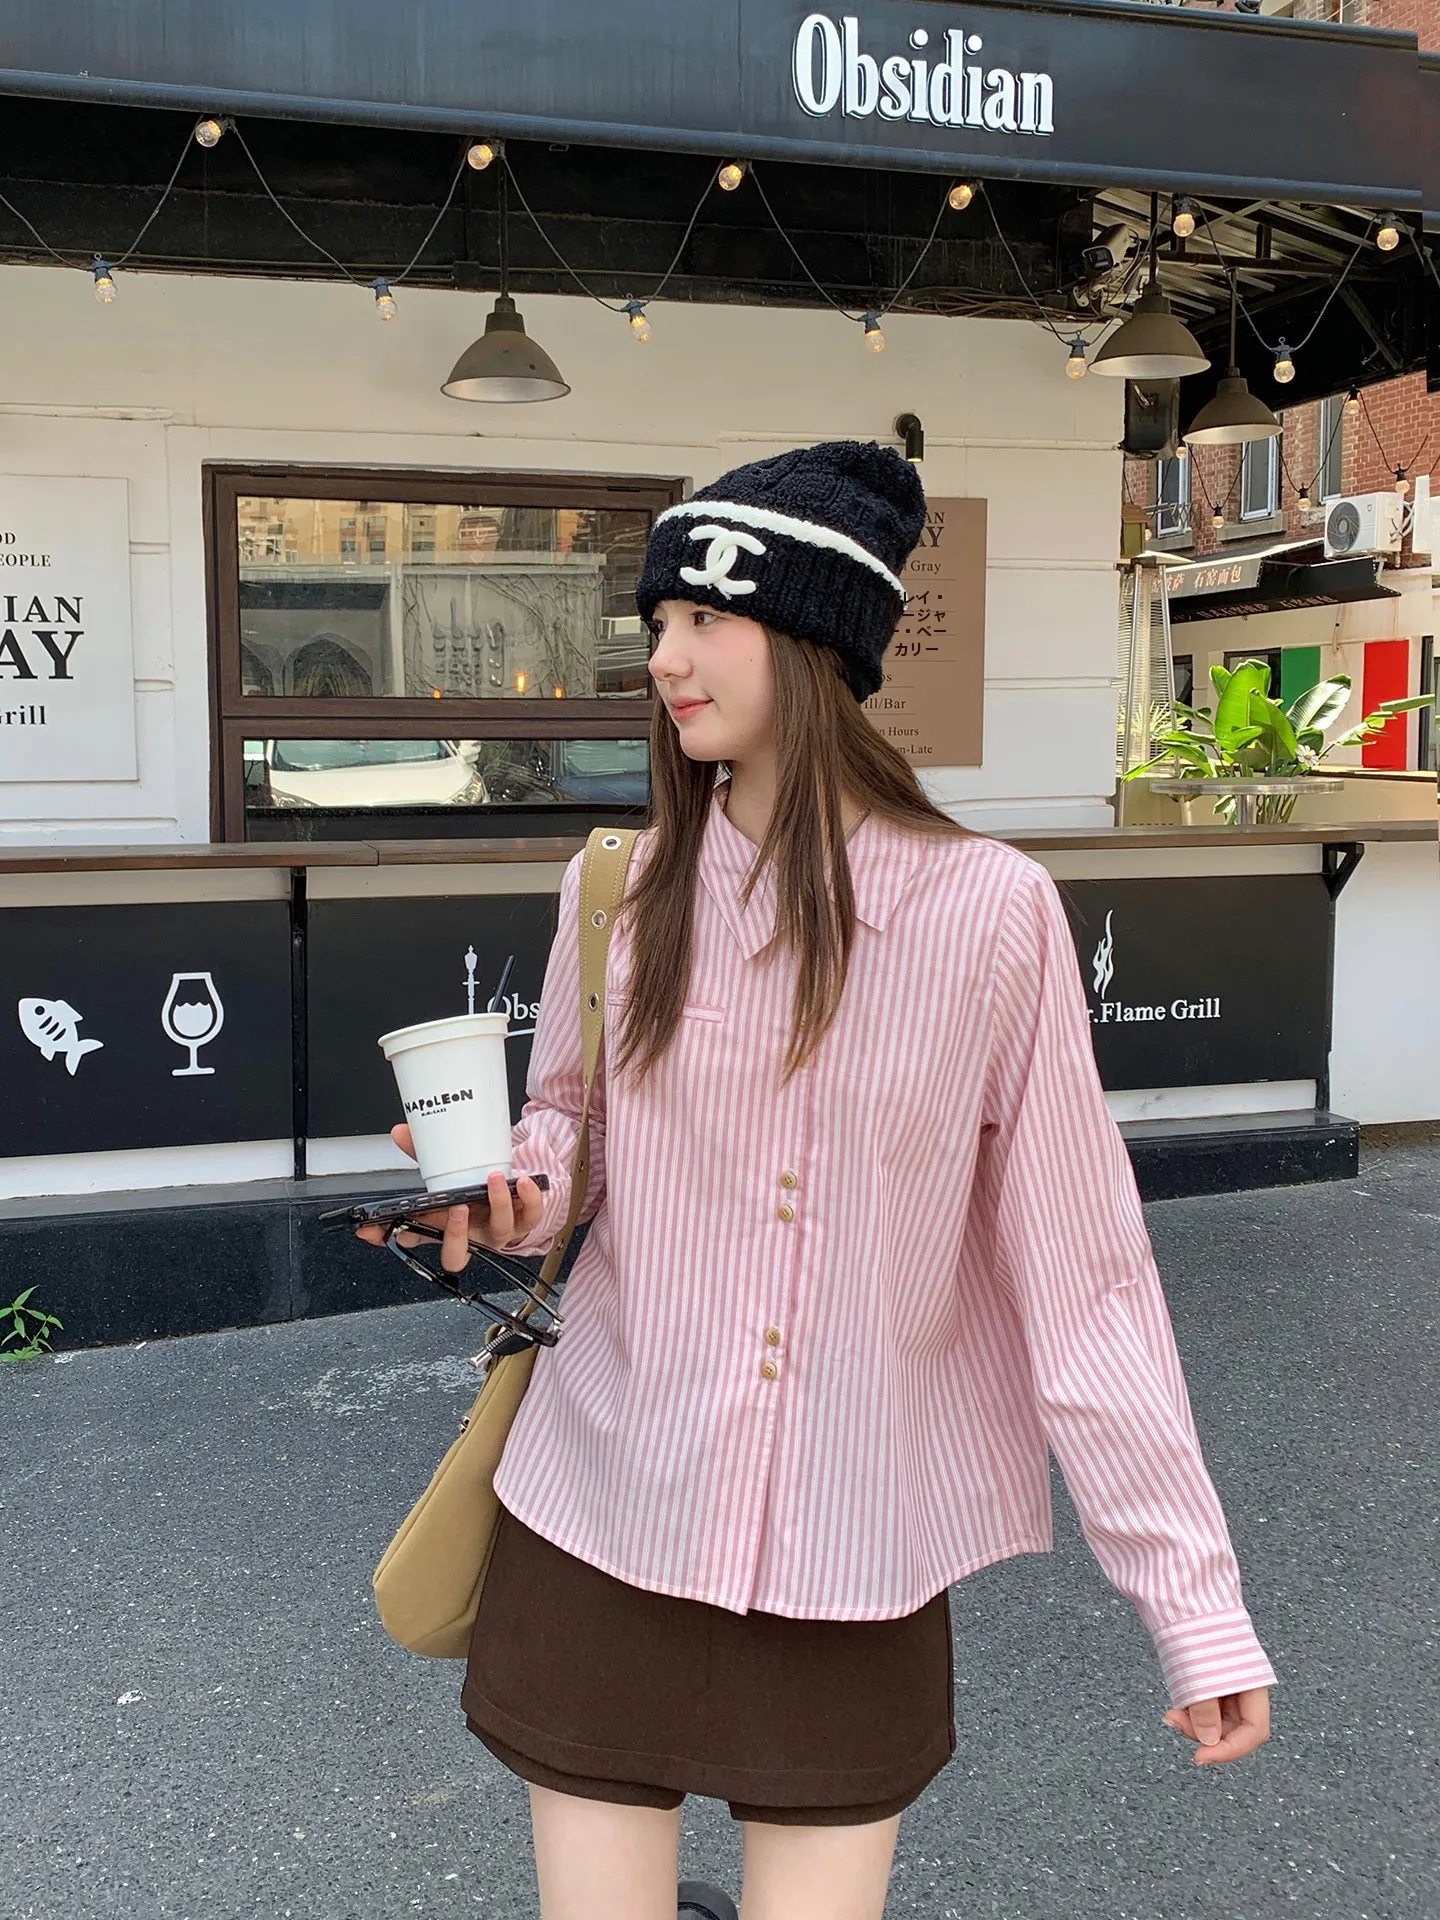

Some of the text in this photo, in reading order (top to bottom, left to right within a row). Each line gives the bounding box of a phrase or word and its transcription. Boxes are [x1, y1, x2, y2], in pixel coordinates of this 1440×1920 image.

[792, 14, 1054, 136] Obsidian
[910, 560, 942, 575] Gray
[3, 595, 84, 624] IAN
[888, 726, 919, 737] Hours
[1170, 998, 1221, 1020] Grill
